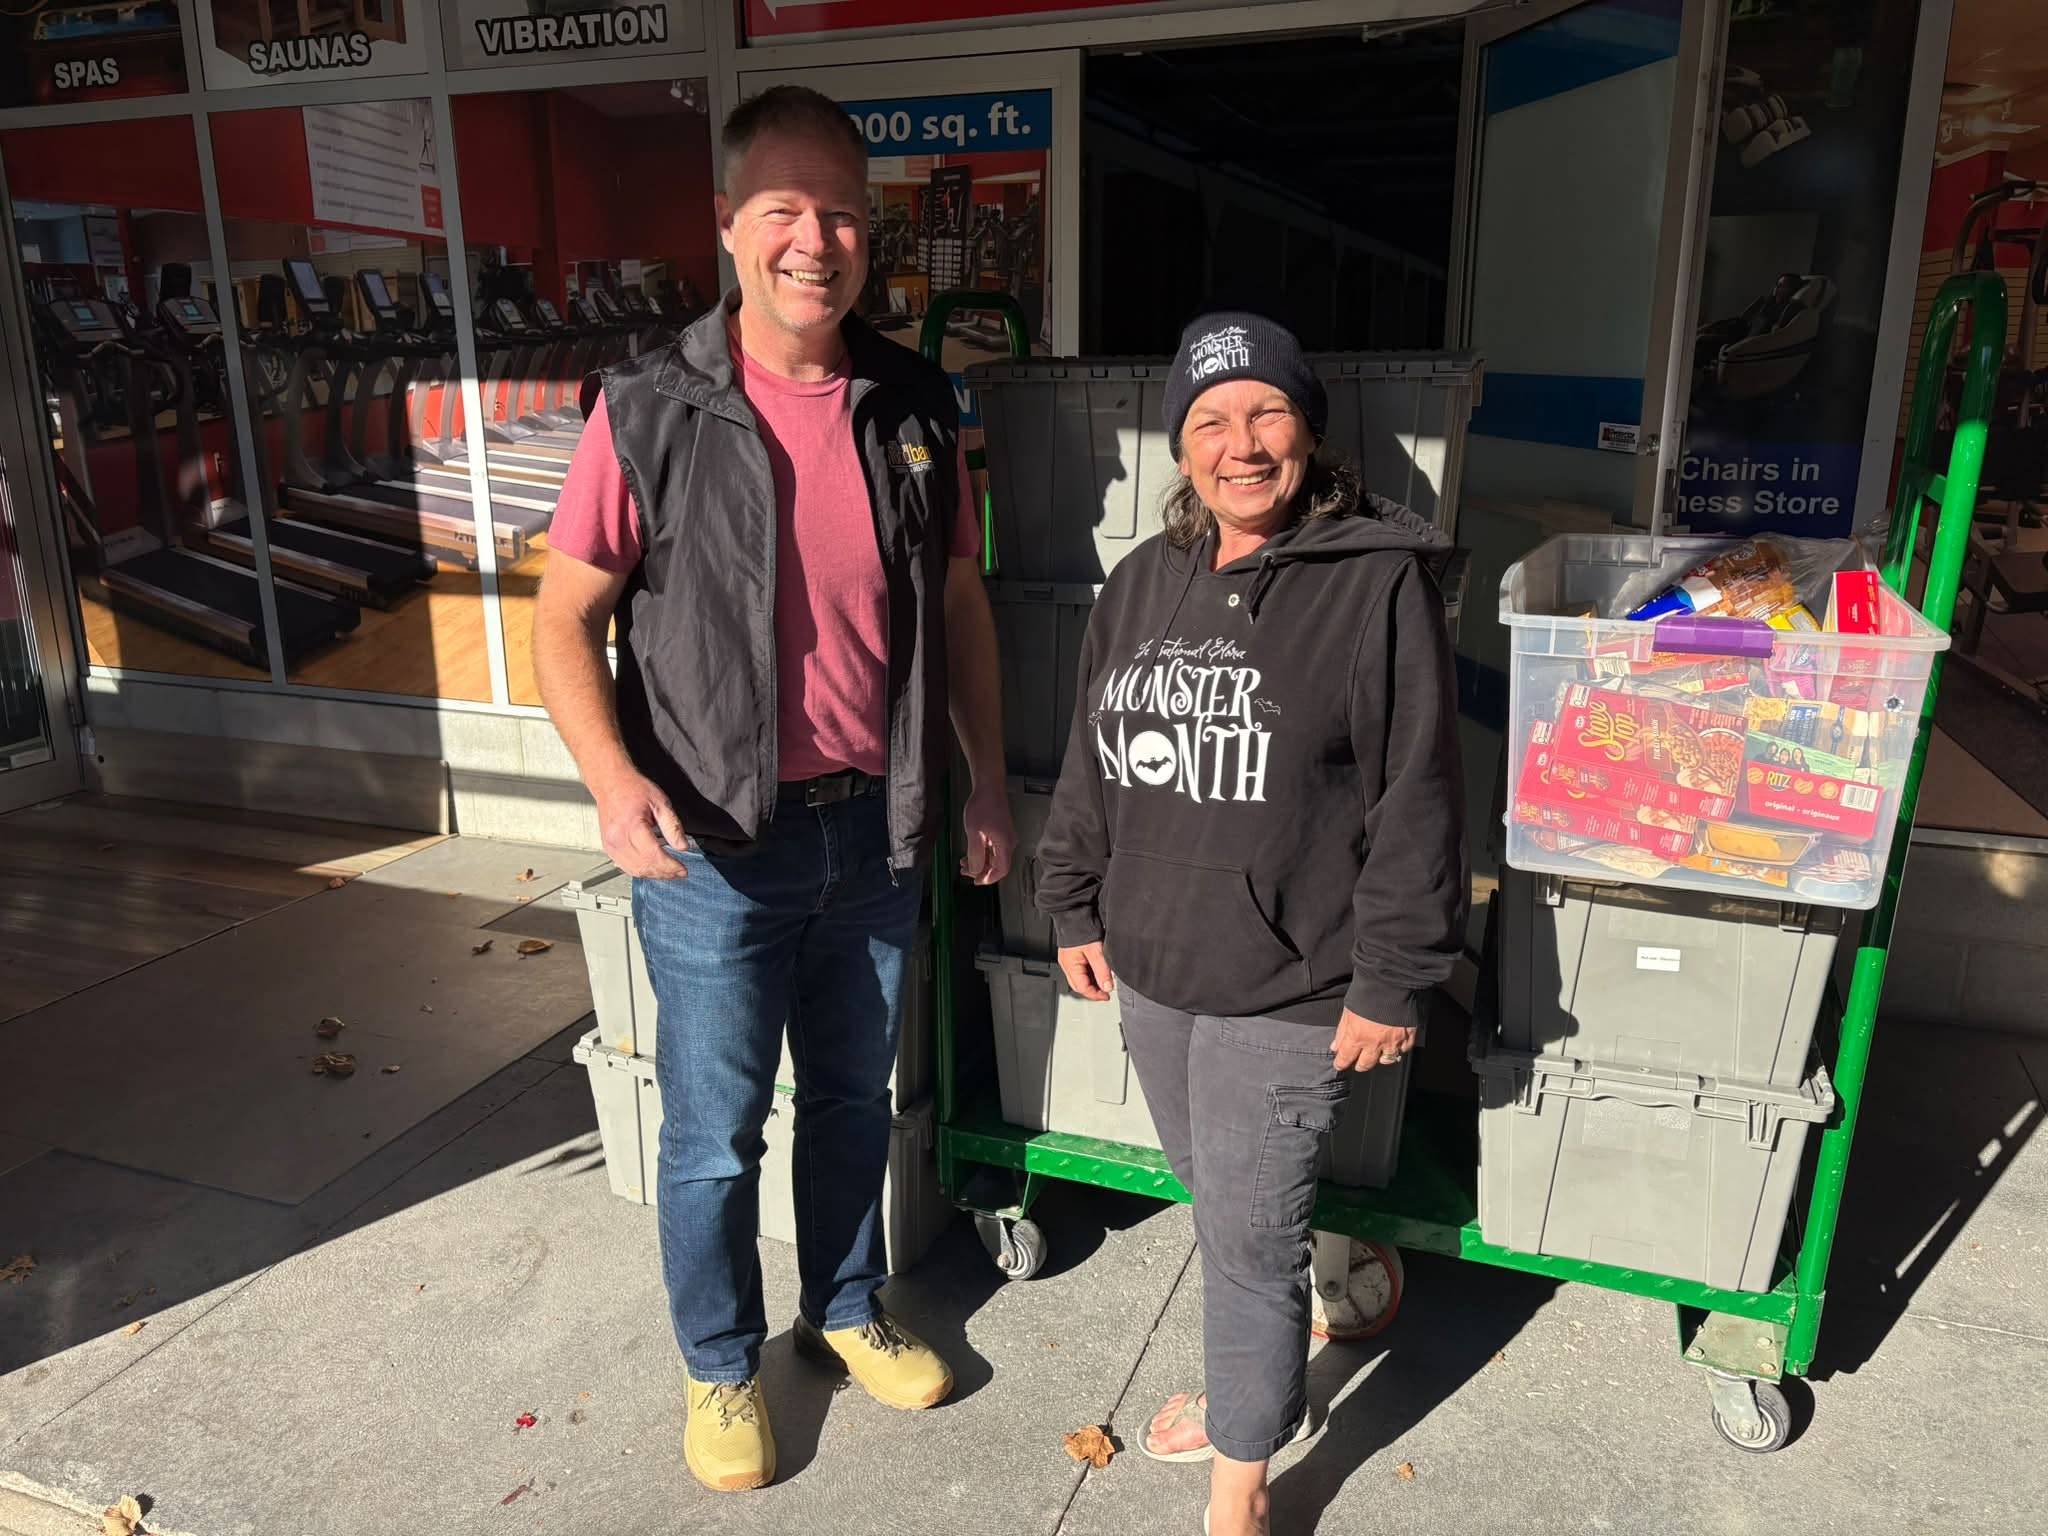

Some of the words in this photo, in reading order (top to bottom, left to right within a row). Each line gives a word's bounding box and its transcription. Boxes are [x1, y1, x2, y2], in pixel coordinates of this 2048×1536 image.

[477, 4, 667, 55] VIBRATION
[249, 32, 372, 74] SAUNAS
[54, 58, 119, 89] SPAS
[922, 113, 978, 147] sq.
[988, 101, 1031, 136] ft.
[1192, 335, 1242, 363] MONSTER
[1192, 347, 1249, 384] MONTH
[1681, 456, 1780, 481] Chairs
[1791, 457, 1820, 481] in
[1754, 490, 1840, 515] Store
[1208, 637, 1247, 663] Elora
[1100, 658, 1262, 731] MONSTER
[1577, 699, 1626, 761] Stove
[1610, 711, 1642, 745] Top
[1097, 712, 1273, 803] MONTH
[1766, 771, 1792, 788] RITZ
[1765, 799, 1796, 813] original
